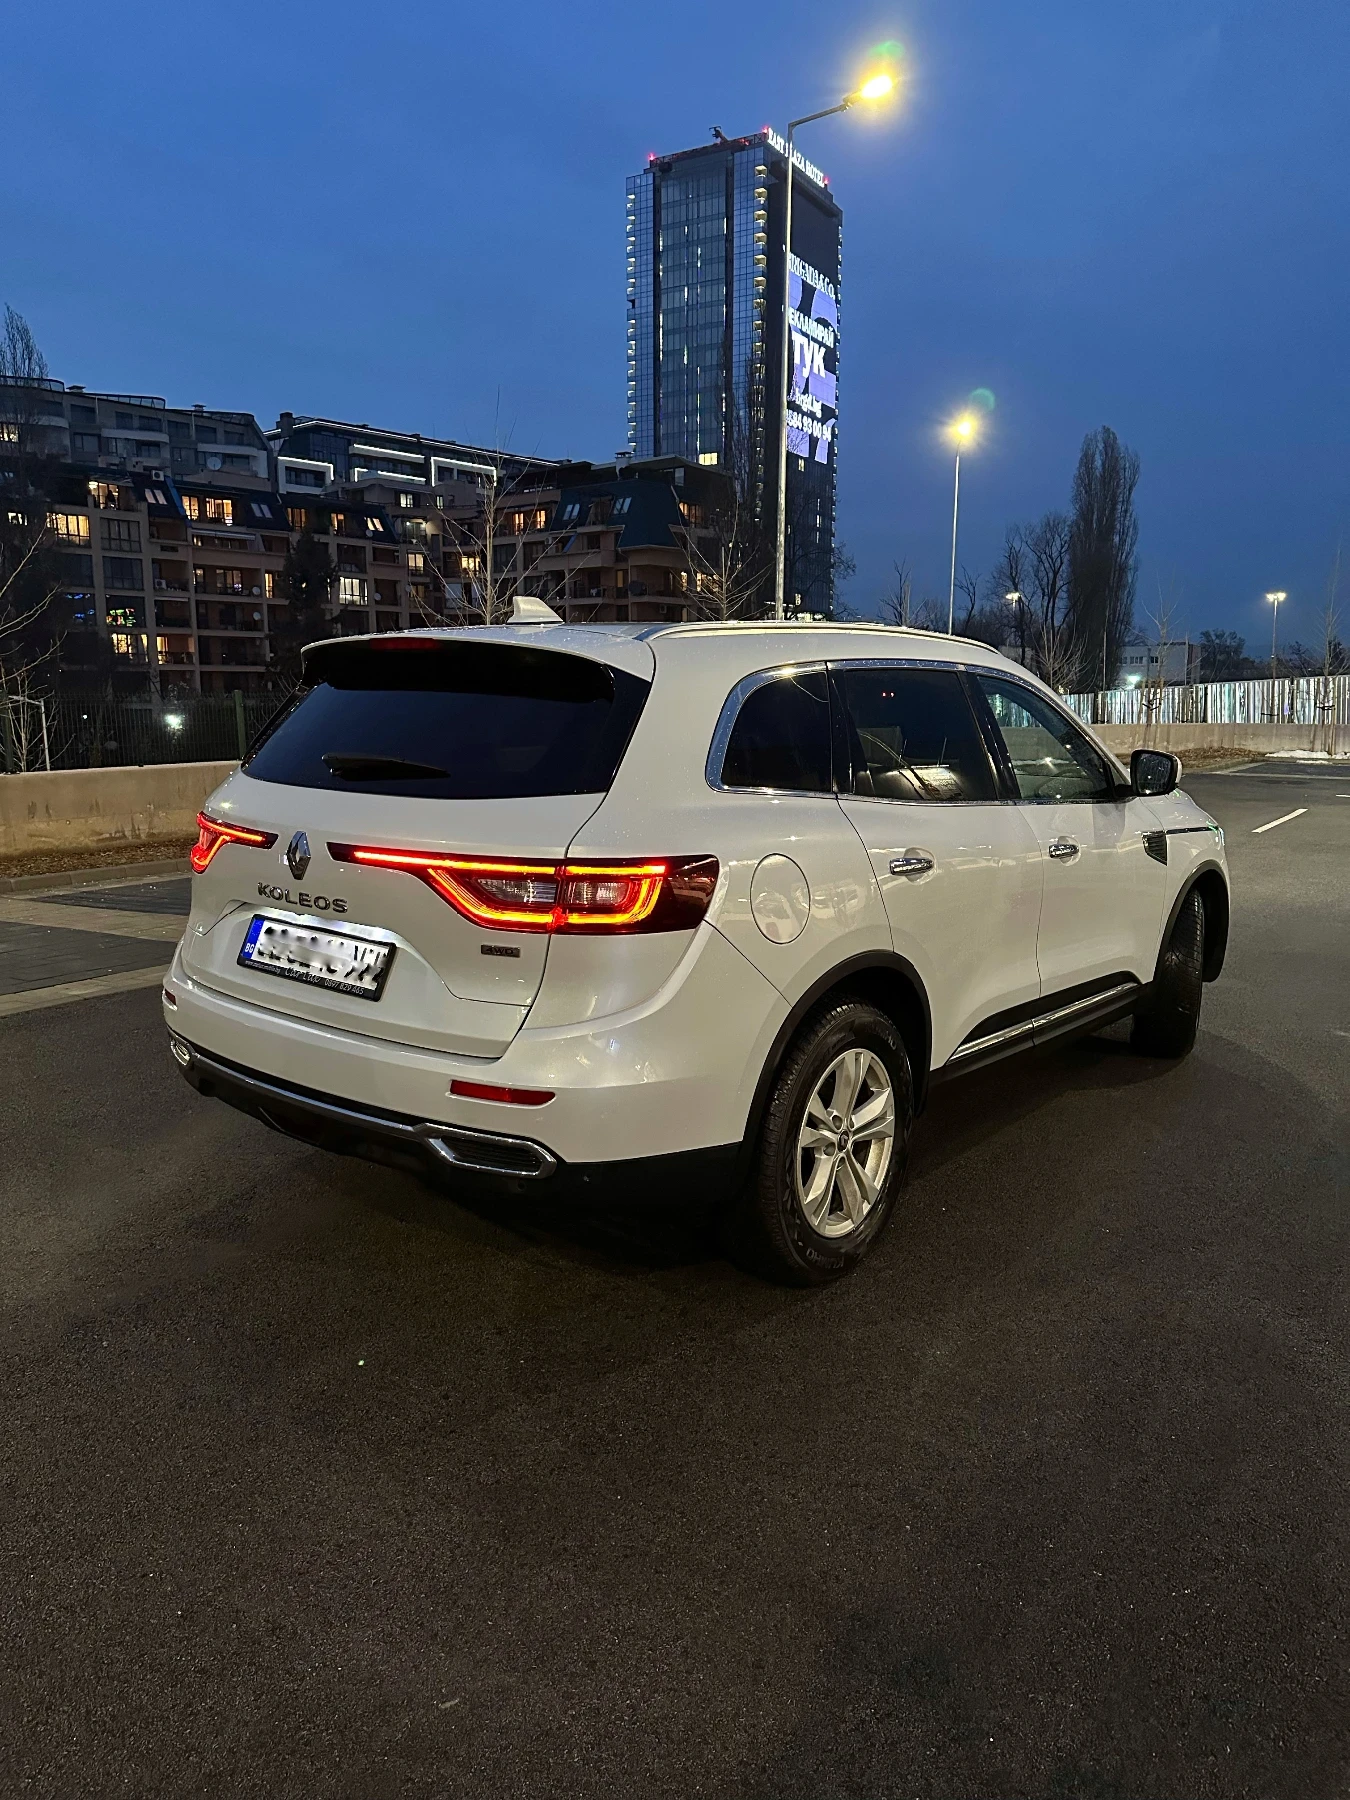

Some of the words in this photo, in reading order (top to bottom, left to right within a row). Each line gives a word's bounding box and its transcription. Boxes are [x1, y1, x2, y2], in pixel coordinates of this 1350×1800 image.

[767, 127, 785, 155] EAST
[805, 159, 825, 188] HOTEL
[788, 306, 835, 349] ЕКЛАМИРАЙ
[802, 415, 813, 435] 93
[812, 419, 823, 439] 00
[822, 424, 832, 443] 94
[257, 881, 348, 914] KOLEOS
[244, 942, 255, 954] BG
[805, 1247, 845, 1269] KUMHO
